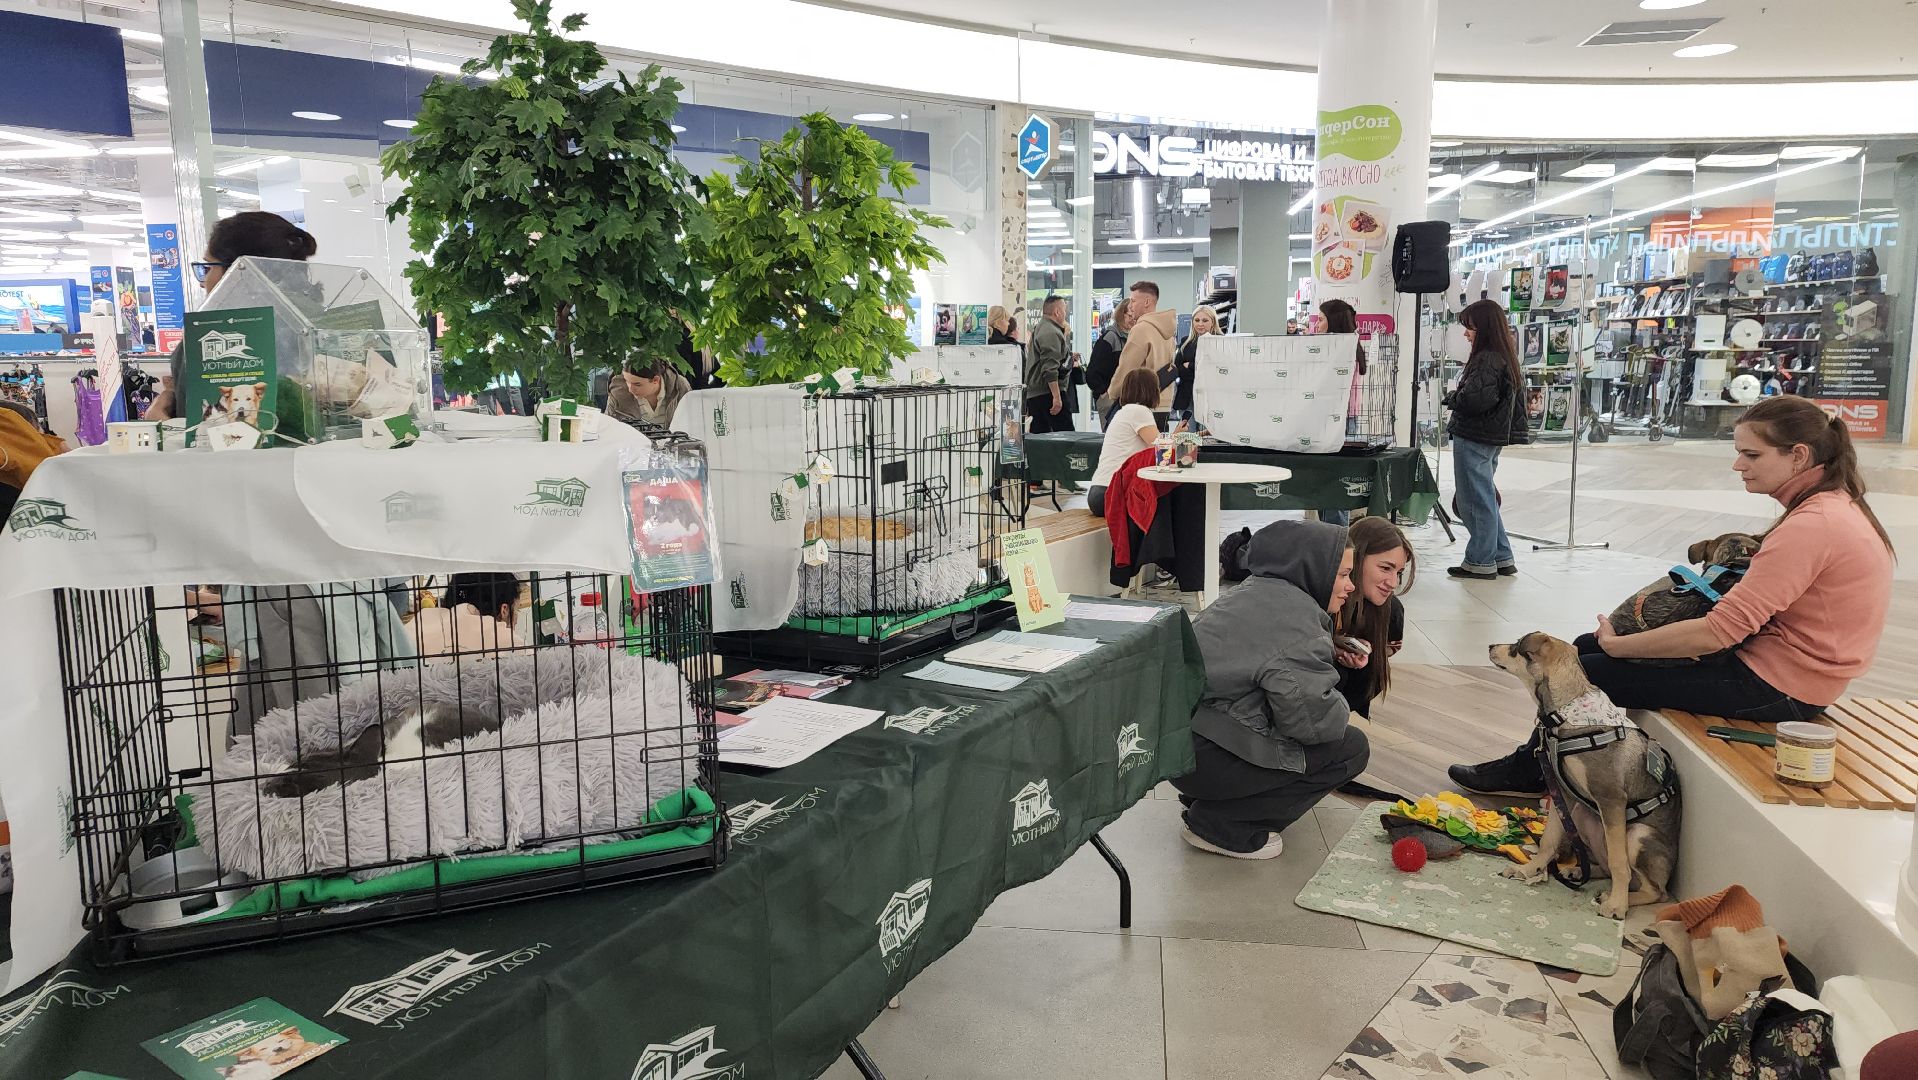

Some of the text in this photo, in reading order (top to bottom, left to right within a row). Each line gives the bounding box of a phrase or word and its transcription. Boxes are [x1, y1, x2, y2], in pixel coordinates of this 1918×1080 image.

[1204, 138, 1291, 161] ЦИФРОВАЯ
[1204, 161, 1315, 182] БЫТОВАЯ ТЕХН
[1341, 164, 1381, 187] ВКУСНО
[202, 359, 264, 371] УЮТНЫЙ ДОМ
[12, 528, 97, 543] УЮТНЫЙ ДОМ
[1137, 750, 1155, 768] ДОМ
[800, 786, 828, 809] ОМ
[1010, 816, 1052, 847] УЮТНЫЙ
[71, 984, 132, 1009] ДОМ
[381, 941, 552, 1032] УЮТНЫЙ ДОМ
[252, 1018, 281, 1035] ДОМ
